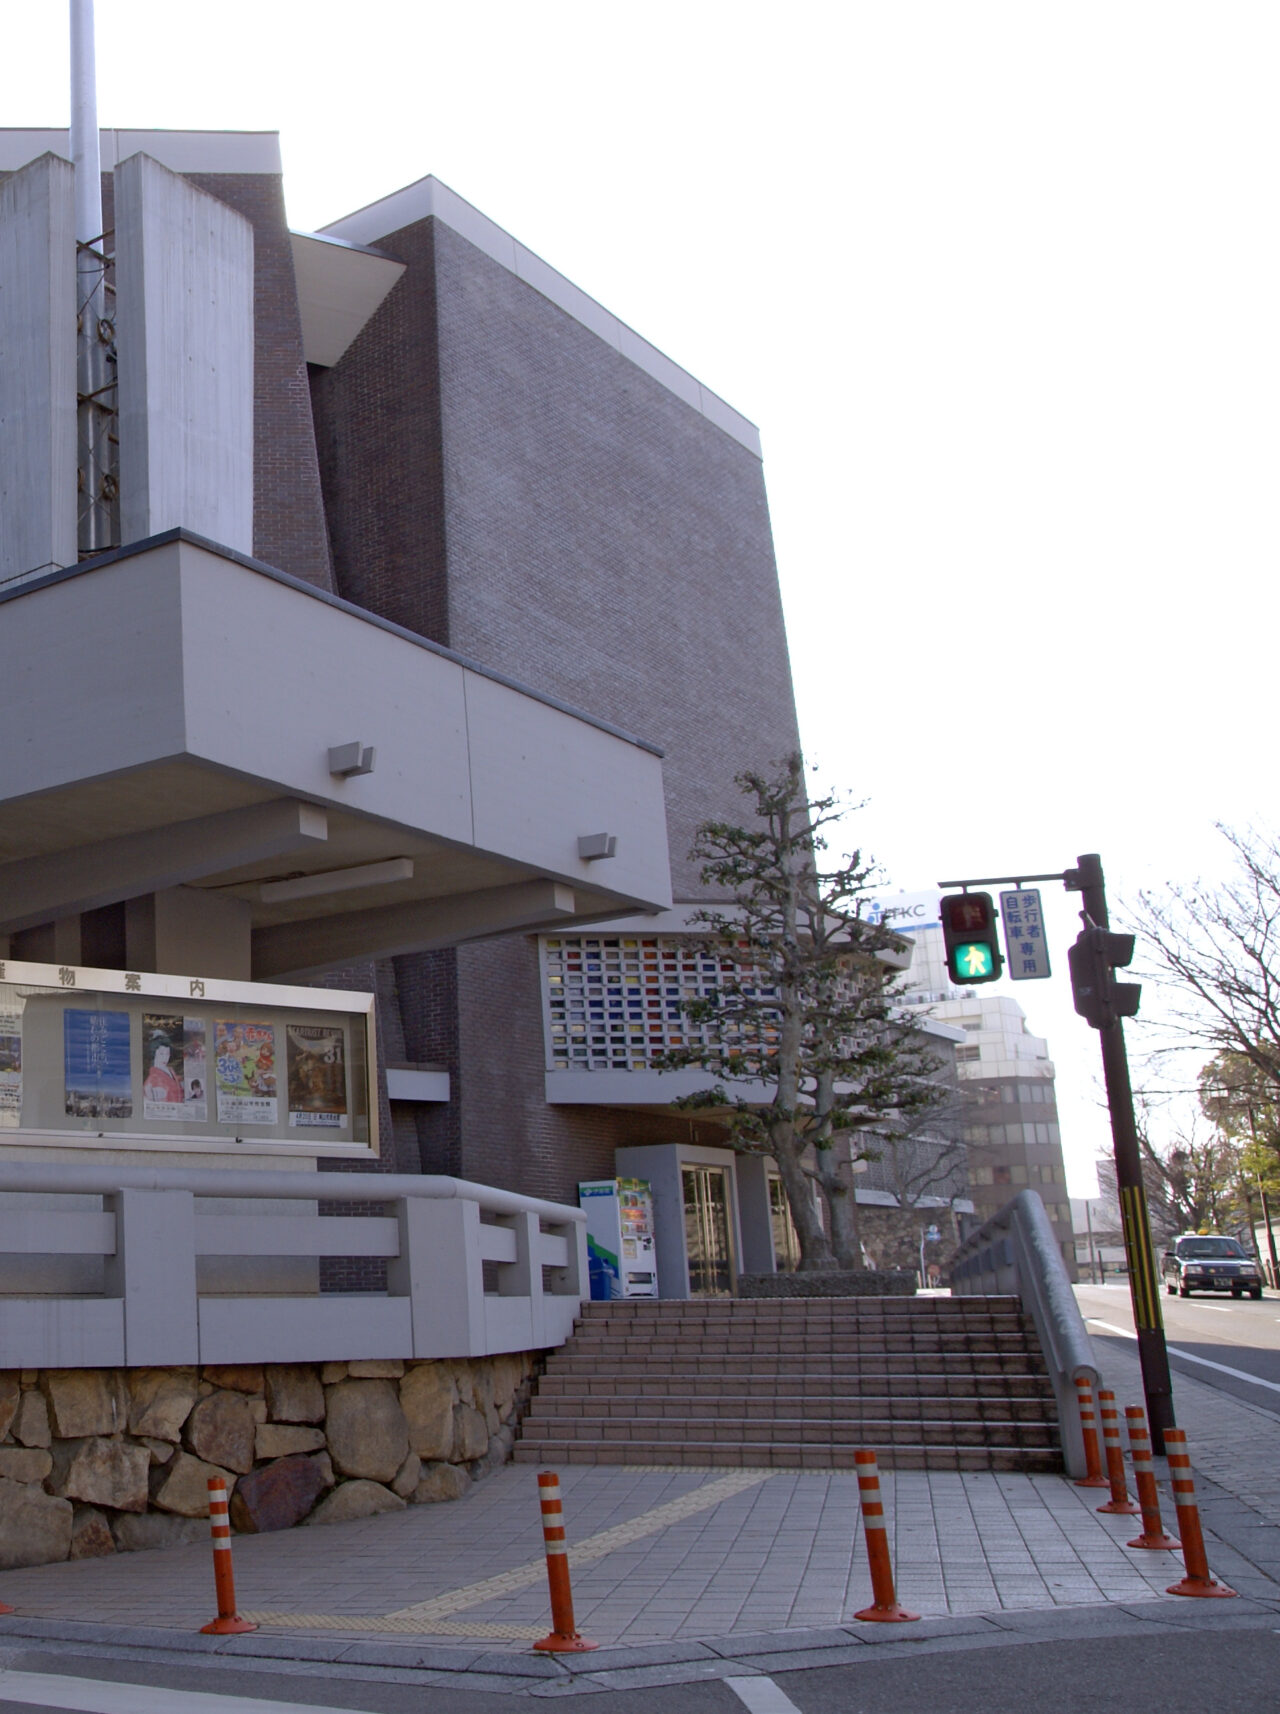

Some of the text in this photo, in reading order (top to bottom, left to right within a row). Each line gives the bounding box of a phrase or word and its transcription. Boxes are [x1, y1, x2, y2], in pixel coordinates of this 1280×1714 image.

[891, 904, 926, 919] TKC
[1006, 896, 1024, 939] 自転車
[1022, 895, 1041, 938] 歩行者
[1019, 942, 1037, 973] 専用
[324, 1042, 343, 1063] 31
